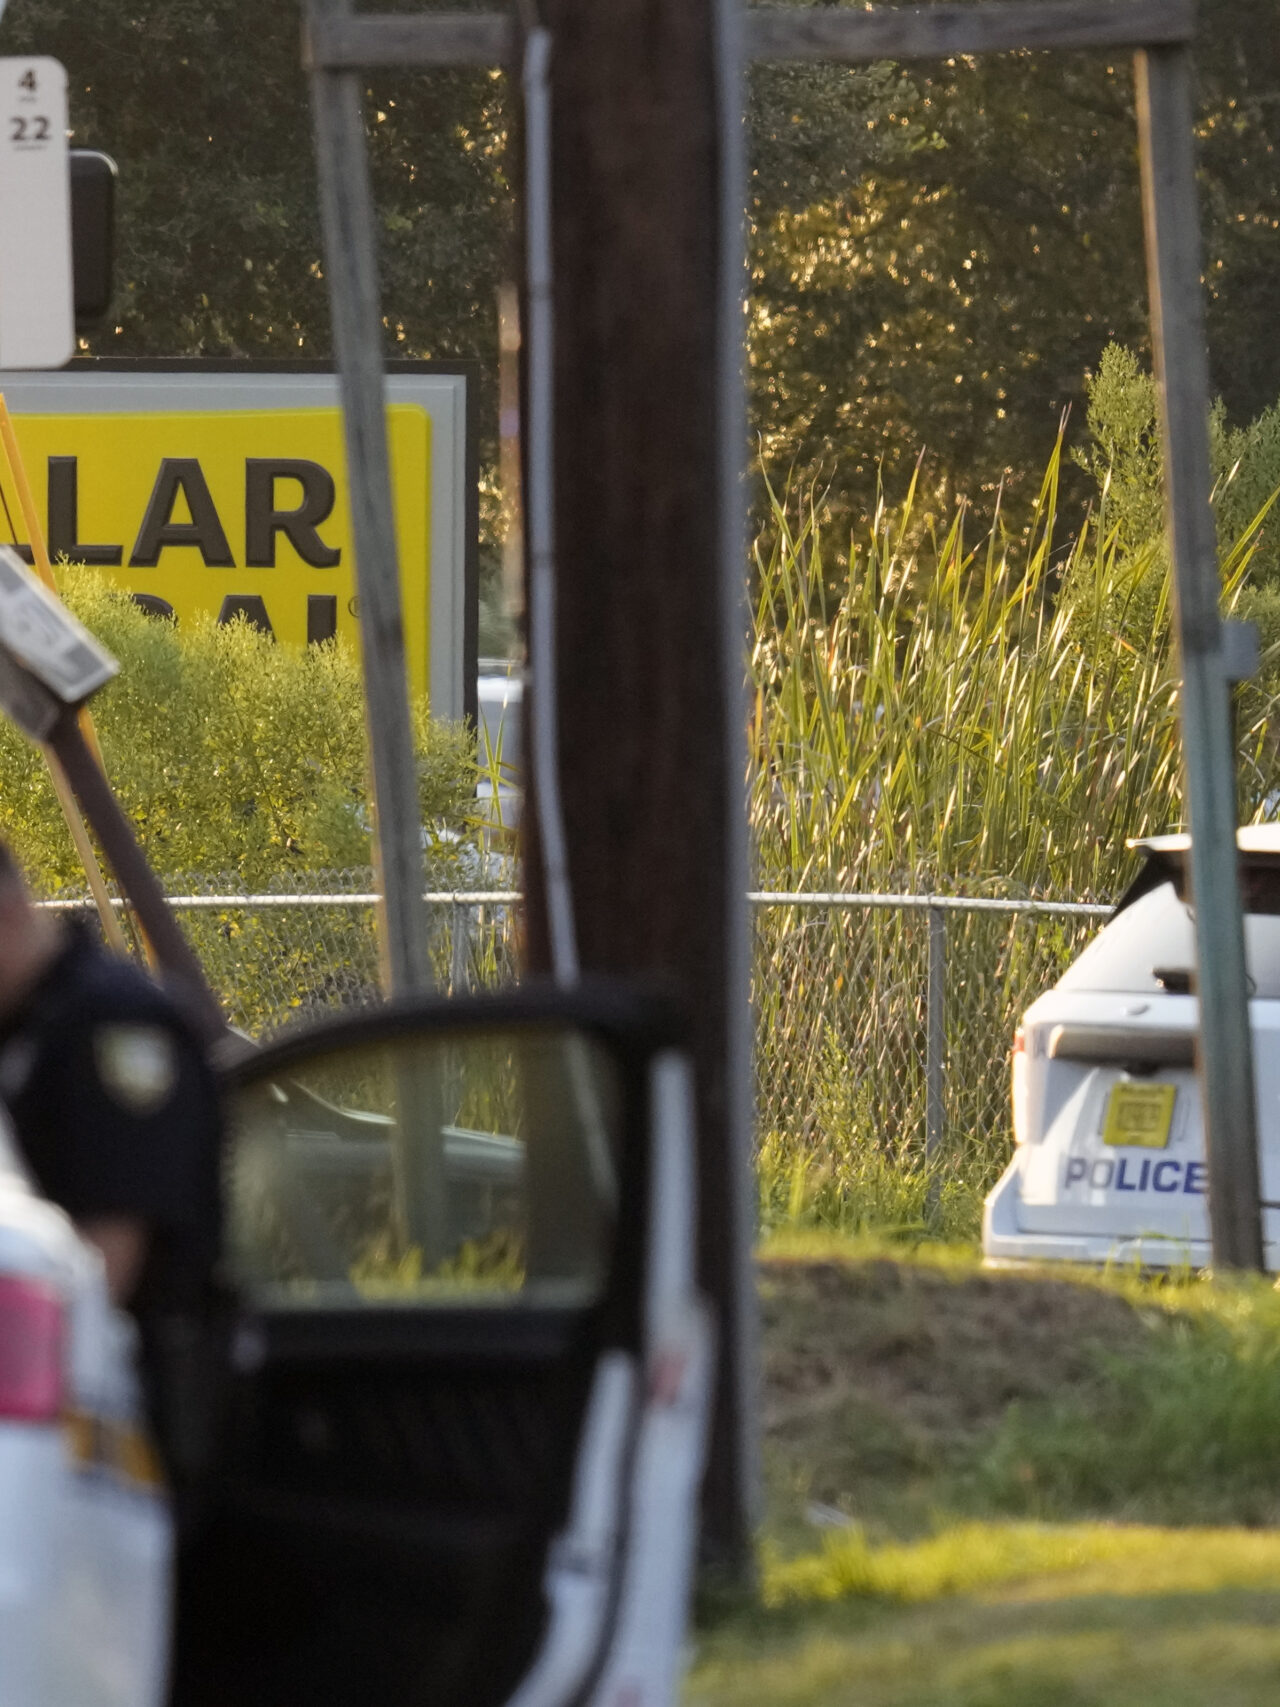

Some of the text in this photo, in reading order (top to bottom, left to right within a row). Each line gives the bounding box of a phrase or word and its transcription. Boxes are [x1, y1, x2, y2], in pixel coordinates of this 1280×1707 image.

[19, 70, 36, 90] 4
[11, 116, 49, 140] 22
[1065, 1157, 1208, 1194] POLICE
